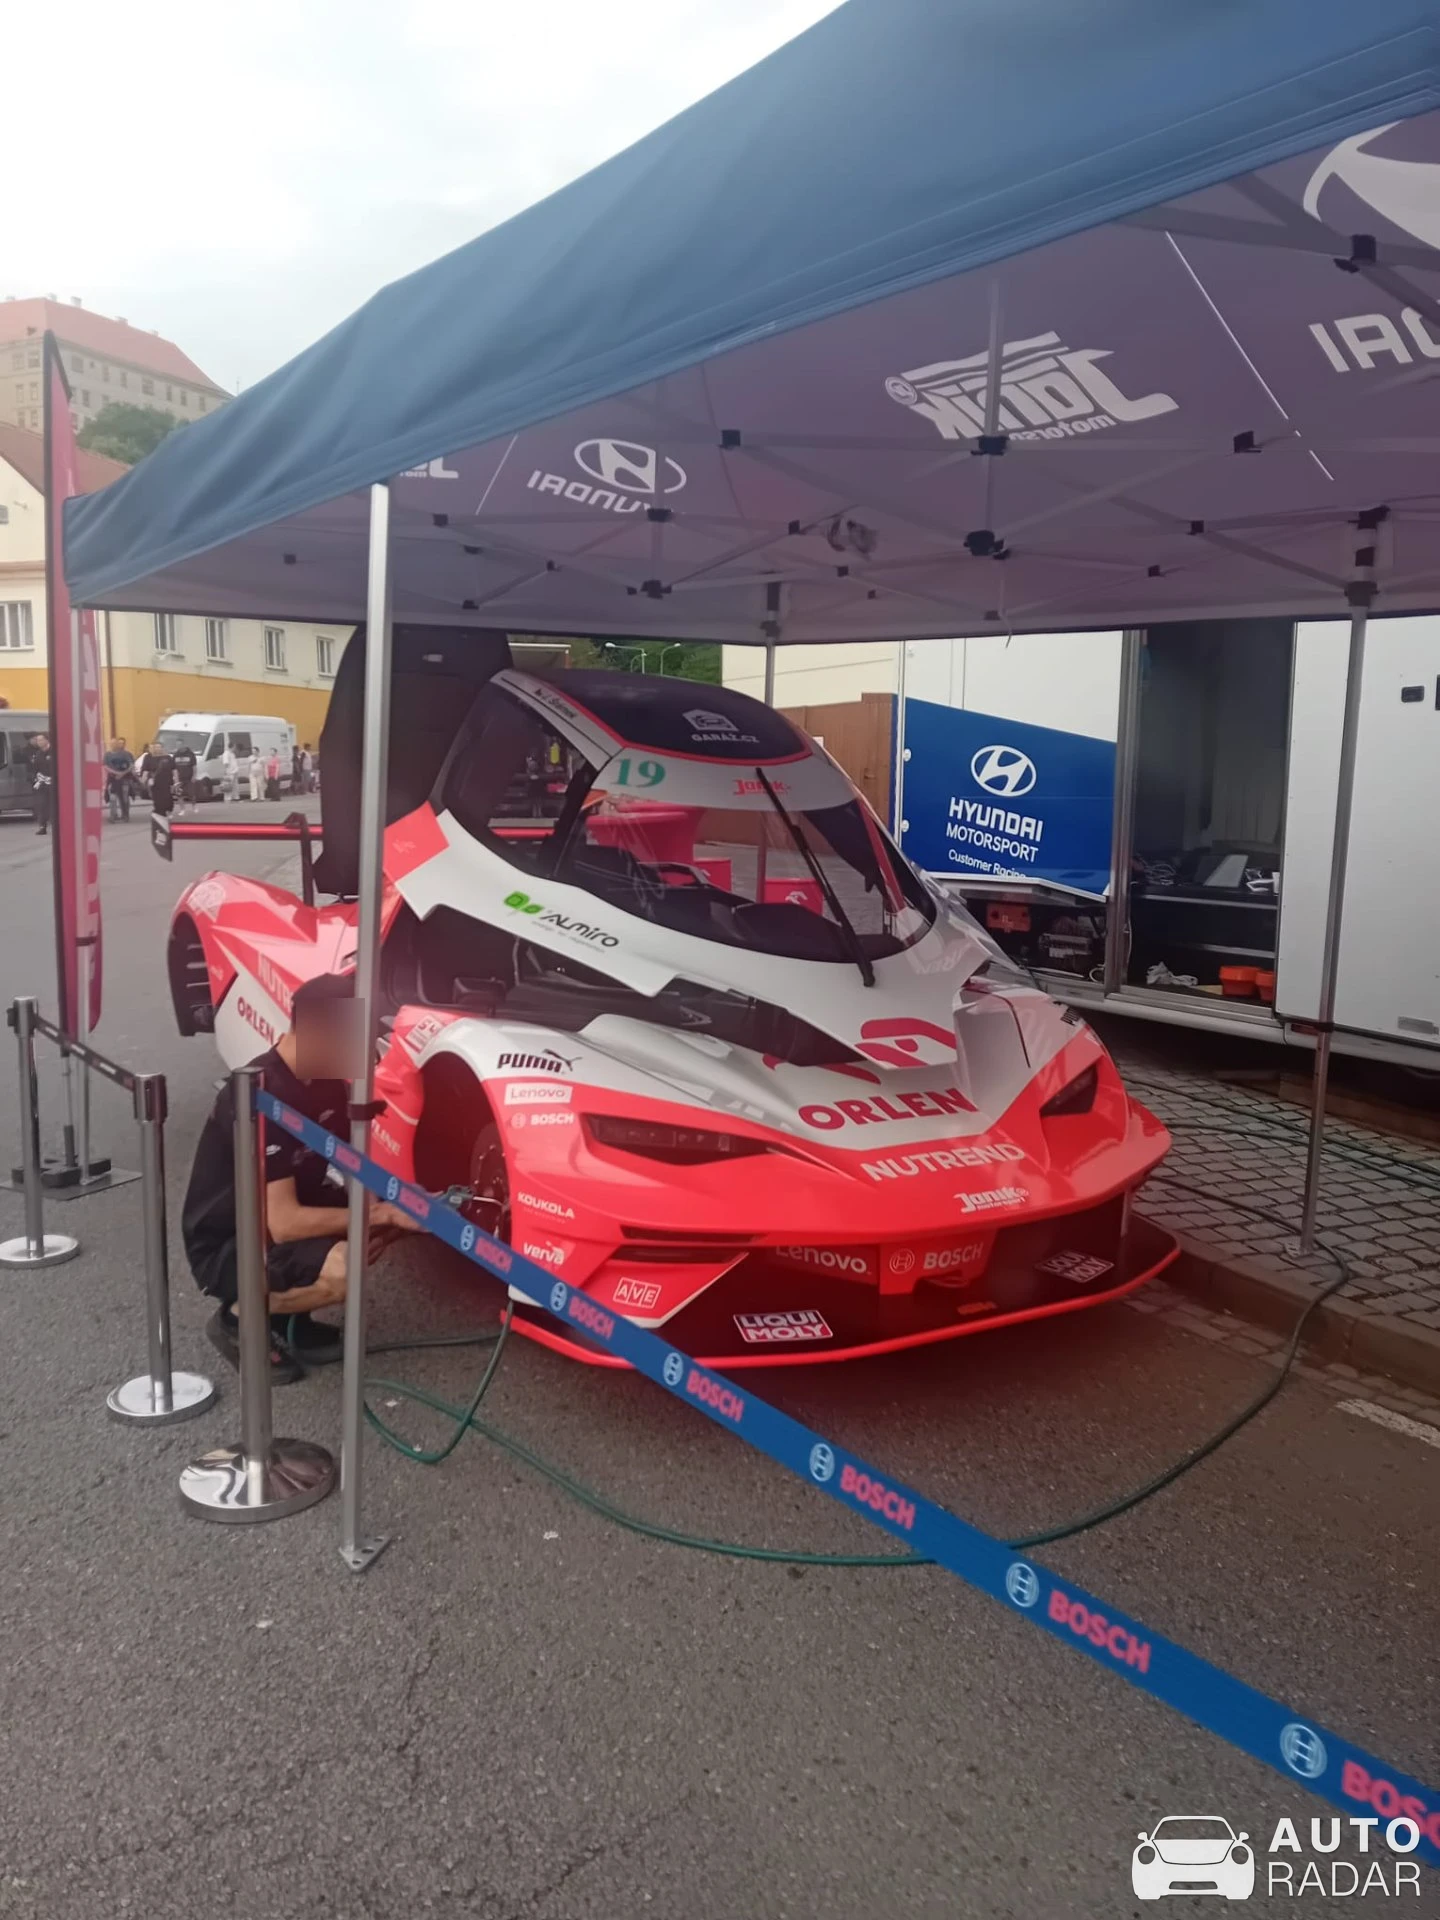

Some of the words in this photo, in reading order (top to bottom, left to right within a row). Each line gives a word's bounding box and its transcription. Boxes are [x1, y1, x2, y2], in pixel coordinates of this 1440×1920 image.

[611, 758, 667, 788] 19
[949, 796, 1044, 842] HYUNDAI
[946, 822, 1040, 863] MOTORSPORT
[948, 849, 992, 873] Customer
[237, 997, 275, 1046] ORLEN
[510, 1086, 566, 1099] Lenovo
[529, 1112, 575, 1125] BOSCH
[798, 1088, 980, 1130] ORLEN
[860, 1142, 1025, 1182] NUTREND
[517, 1191, 575, 1219] KOUKOLA
[523, 1241, 565, 1266] verva
[776, 1245, 868, 1274] Lenovo
[922, 1242, 984, 1270] BOSCH
[617, 1284, 657, 1303] AVE
[568, 1296, 615, 1340] BOSCH
[740, 1311, 819, 1328] LIQUI
[745, 1323, 824, 1341] MOLY
[686, 1369, 744, 1422] BOSCH
[840, 1464, 915, 1530] BOSCH
[1048, 1590, 1151, 1674] BOSCH
